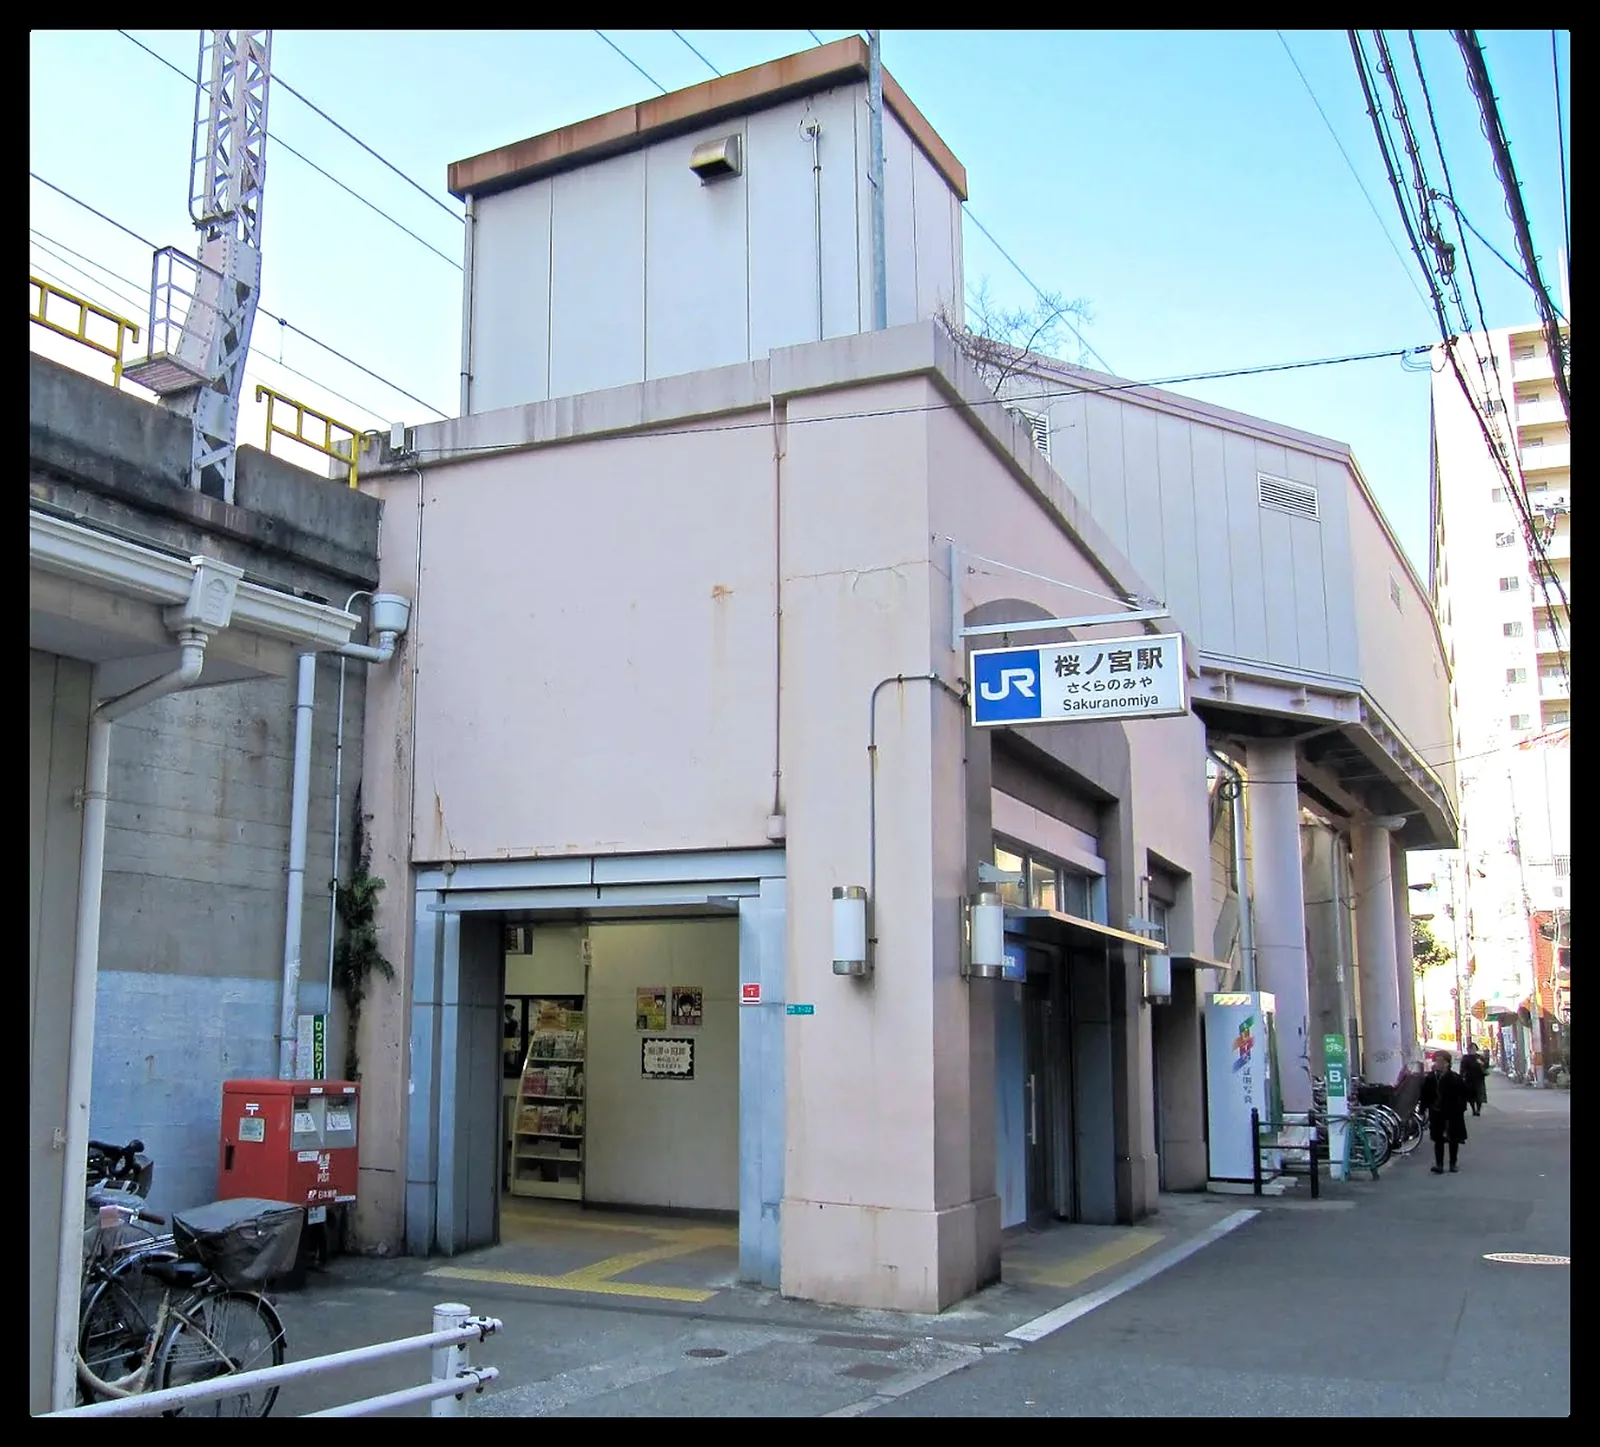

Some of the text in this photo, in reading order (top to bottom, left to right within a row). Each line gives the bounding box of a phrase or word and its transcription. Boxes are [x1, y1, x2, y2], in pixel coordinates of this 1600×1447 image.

[1055, 646, 1163, 678] 桜ノ宮駅
[980, 667, 1036, 701] JR
[1067, 677, 1153, 694] さくらのみや
[1063, 694, 1159, 711] Sakuranomiya
[1330, 1070, 1341, 1082] B
